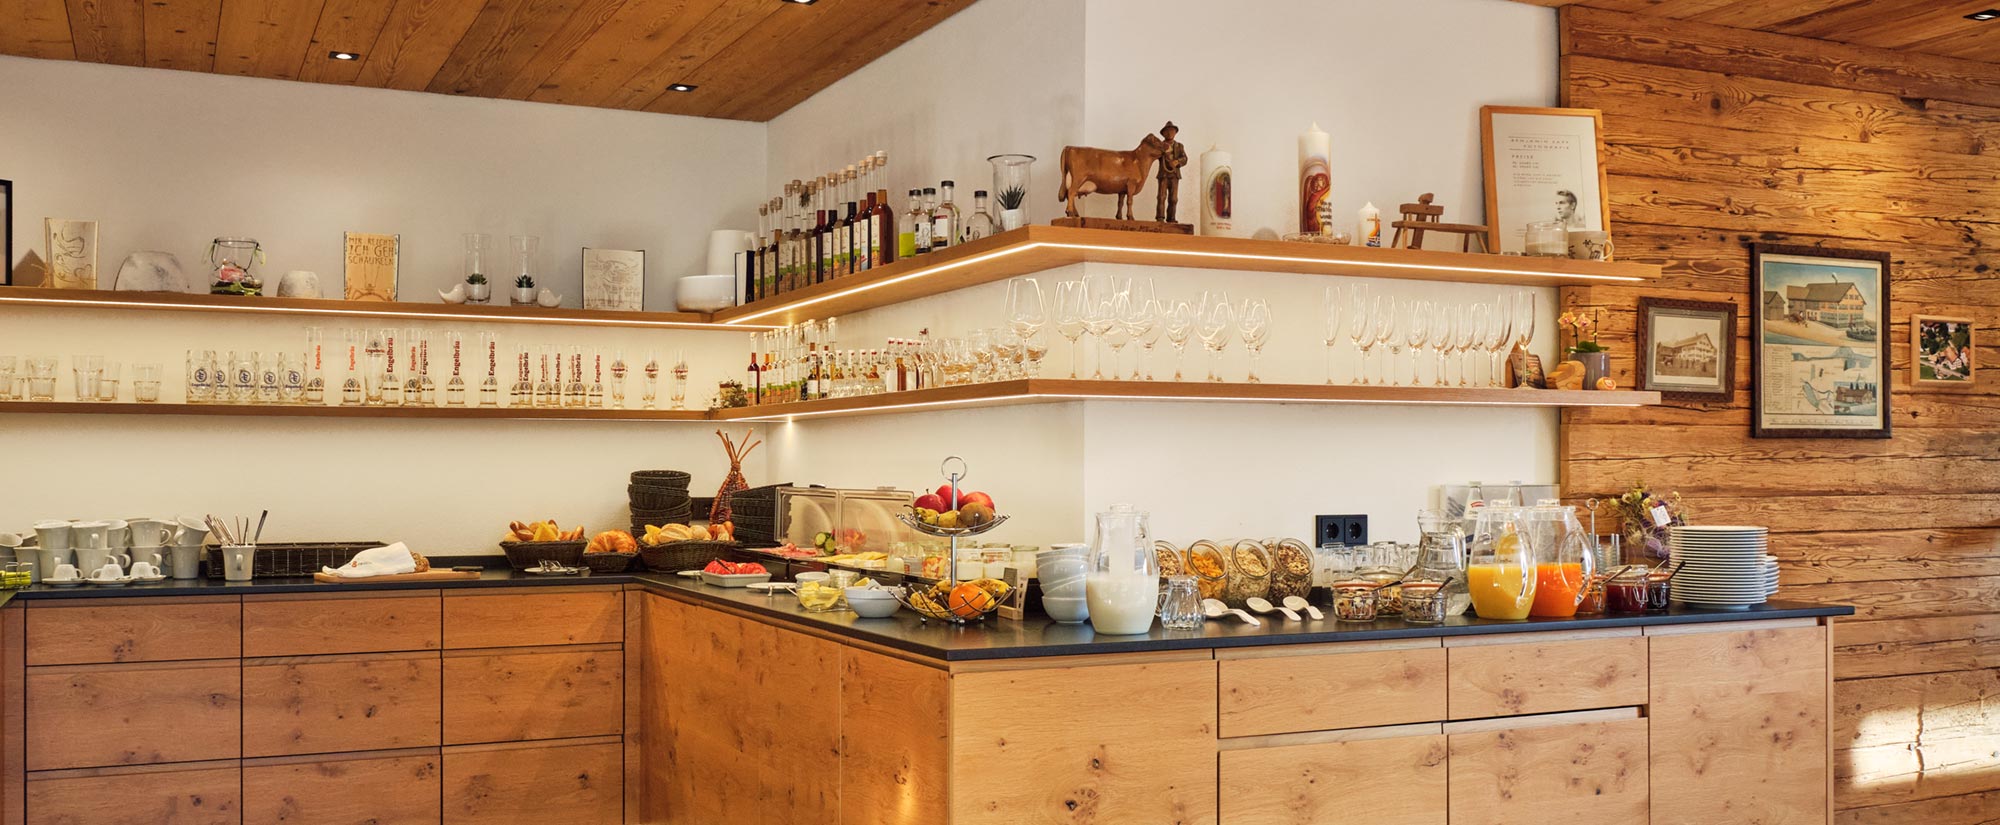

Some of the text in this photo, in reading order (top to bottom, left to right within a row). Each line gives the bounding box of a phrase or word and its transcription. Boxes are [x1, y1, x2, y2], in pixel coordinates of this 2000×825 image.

[348, 237, 362, 245] MIR
[349, 244, 394, 257] ICH GEH
[386, 337, 396, 373] Engelbräu
[453, 340, 461, 376] Engelbräu
[488, 341, 497, 376] Engelbräu
